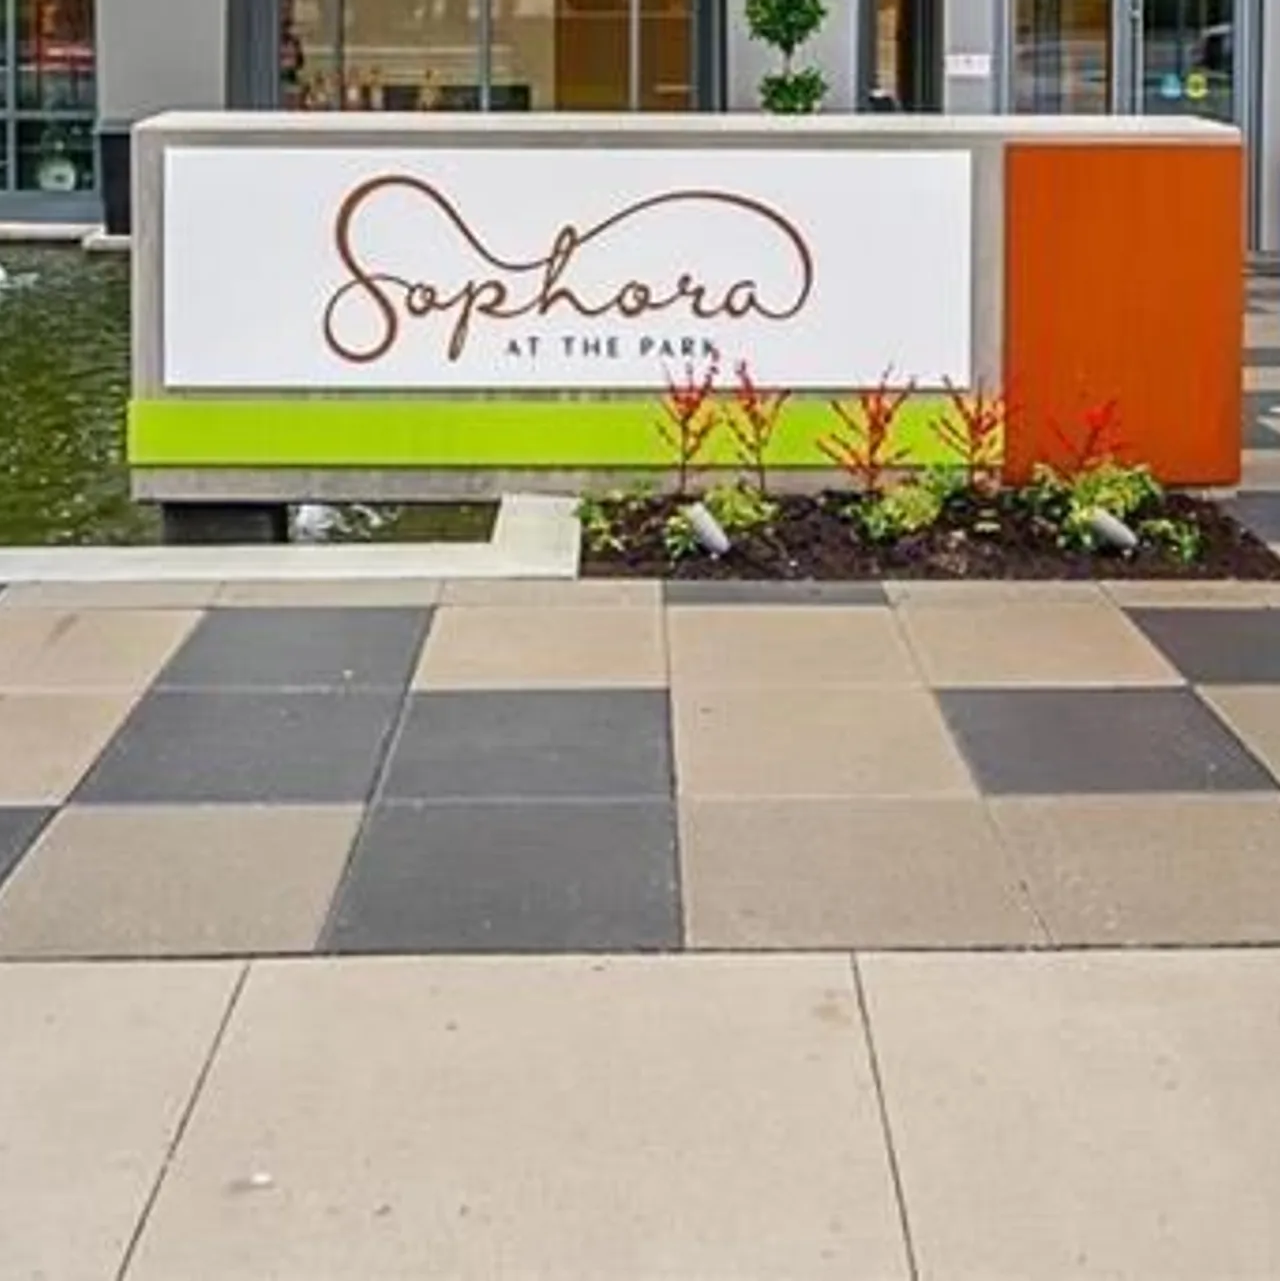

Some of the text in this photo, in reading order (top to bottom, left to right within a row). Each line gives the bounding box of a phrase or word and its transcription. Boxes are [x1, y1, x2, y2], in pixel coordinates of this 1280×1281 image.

[323, 174, 813, 364] Sophora
[507, 335, 717, 358] AT THE PARK
